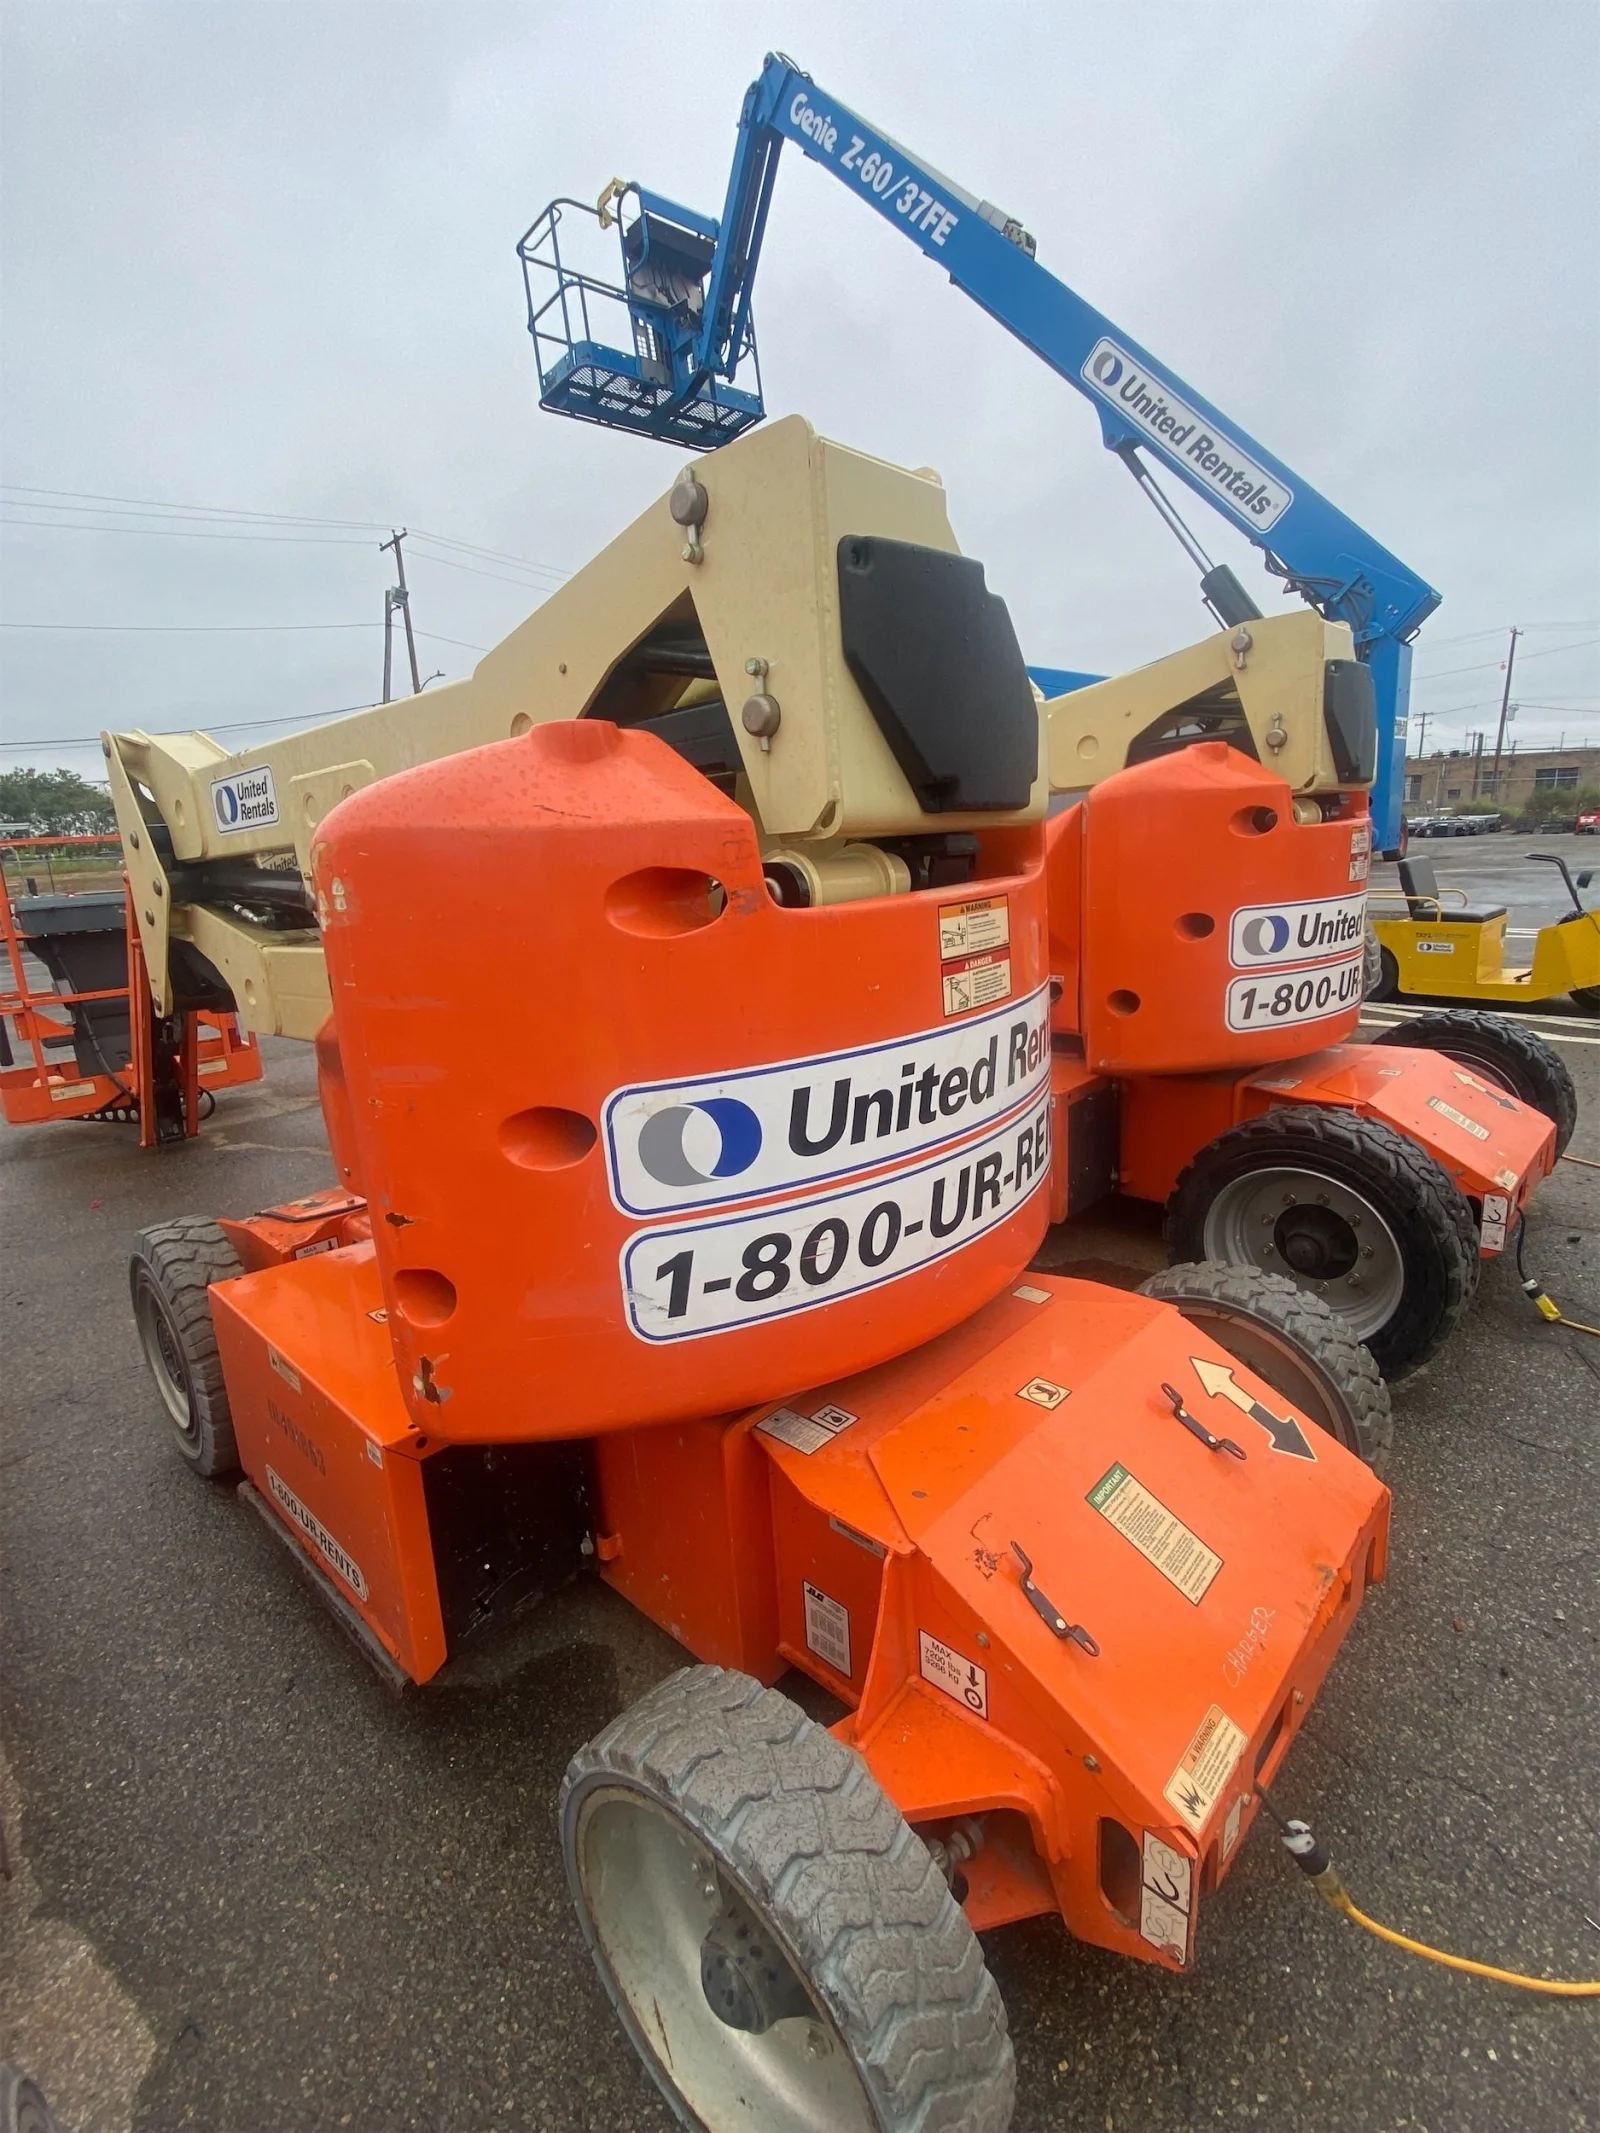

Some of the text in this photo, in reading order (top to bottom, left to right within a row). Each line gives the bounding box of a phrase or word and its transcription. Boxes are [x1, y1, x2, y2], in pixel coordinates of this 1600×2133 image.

[790, 93, 959, 247] Genie Z-60/37FE
[1119, 375, 1272, 515] United Rentals
[236, 775, 268, 801] United
[240, 797, 275, 821] Rentals
[965, 900, 991, 913] WARNING
[1297, 903, 1364, 948] United
[970, 955, 993, 969] DANGER
[788, 1035, 998, 1157] United
[1093, 1469, 1124, 1505] IMPORTANT
[270, 1475, 361, 1588] 1-800-UR-RENTS
[925, 1646, 961, 1676] 7200 lbs
[931, 1641, 952, 1661] MAX
[1222, 1606, 1276, 1688] CHARGER
[948, 1671, 960, 1685] kg
[1192, 1718, 1216, 1756] WARNING
